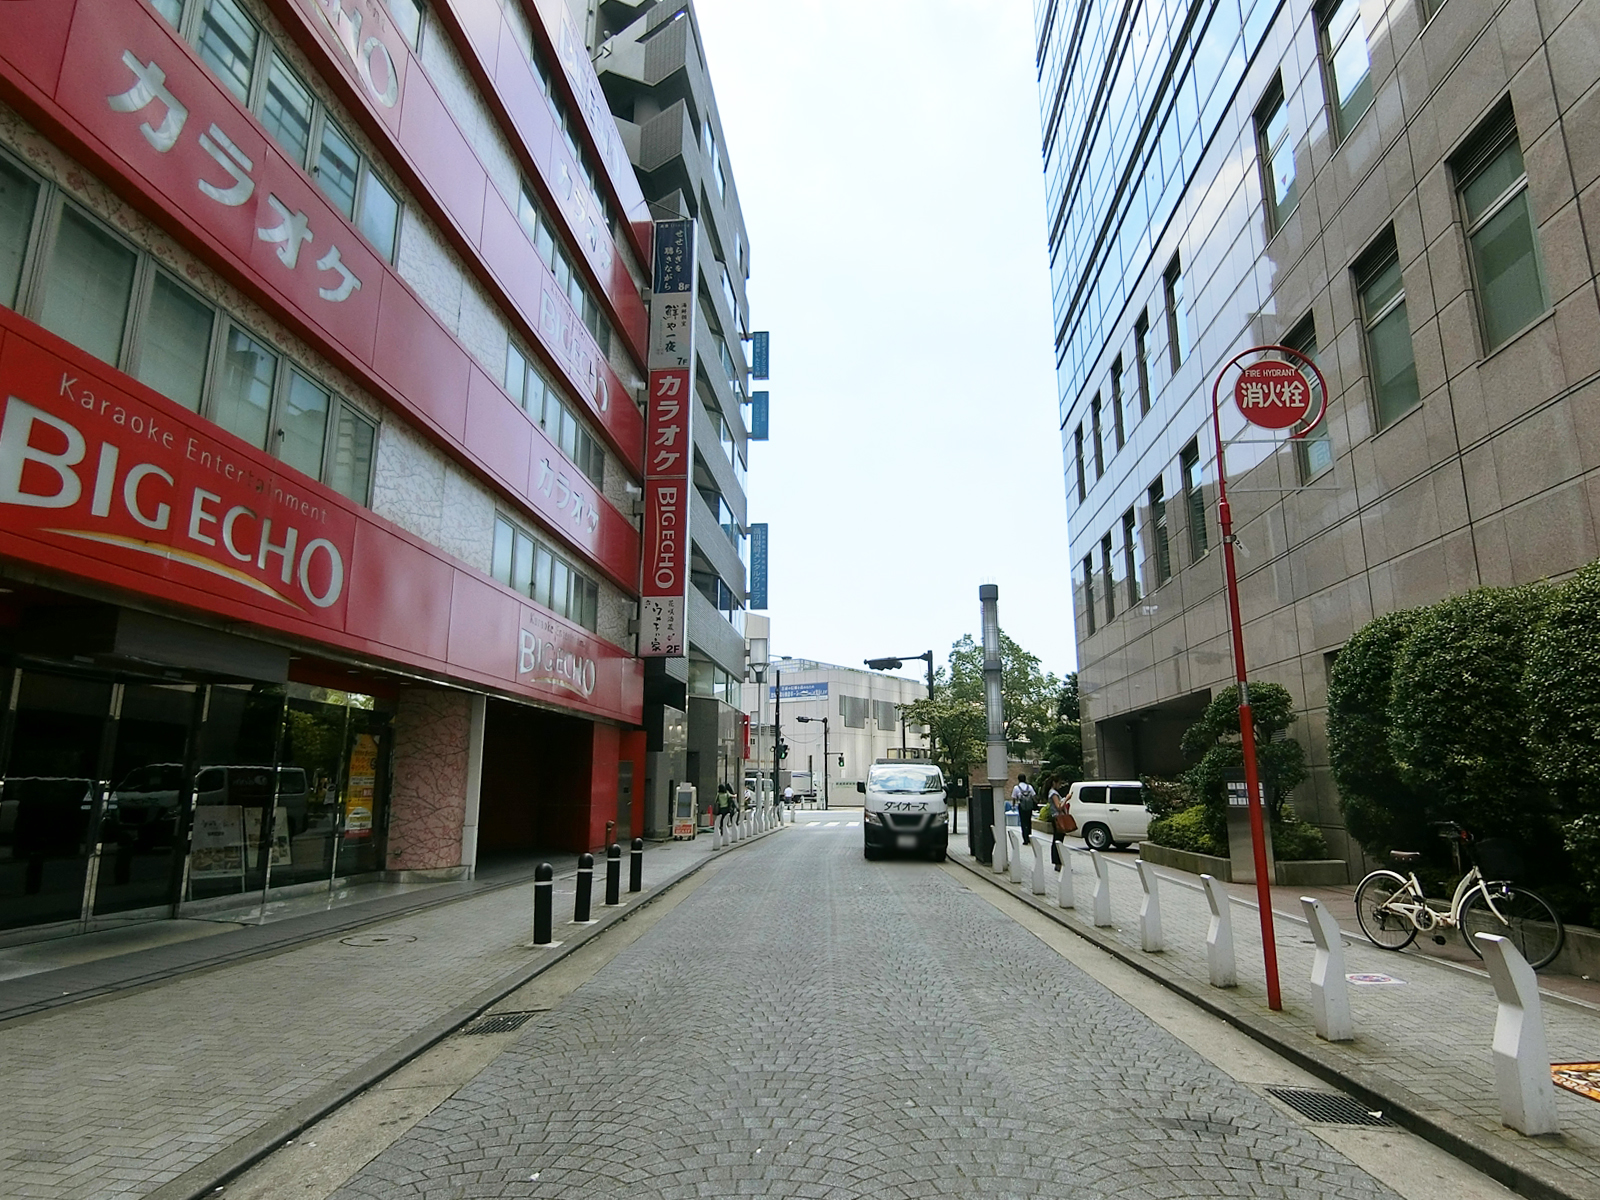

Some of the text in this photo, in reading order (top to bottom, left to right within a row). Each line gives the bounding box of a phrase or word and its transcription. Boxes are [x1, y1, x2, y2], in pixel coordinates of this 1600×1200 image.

[107, 49, 362, 302] カラオケ
[678, 282, 690, 291] 8F
[677, 357, 688, 366] 7F
[1240, 380, 1305, 409] 消火栓
[1244, 368, 1296, 378] FIRE HYDRANT
[59, 371, 329, 525] Karaoke Entertainment
[653, 375, 682, 472] カラオケ
[0, 394, 345, 609] BIG ECHO
[537, 457, 599, 534] カラオケ
[655, 487, 678, 589] BIG ECHO
[519, 628, 596, 696] BIG ECHO
[666, 645, 680, 654] 2F
[884, 801, 928, 811] ダイオーズ
